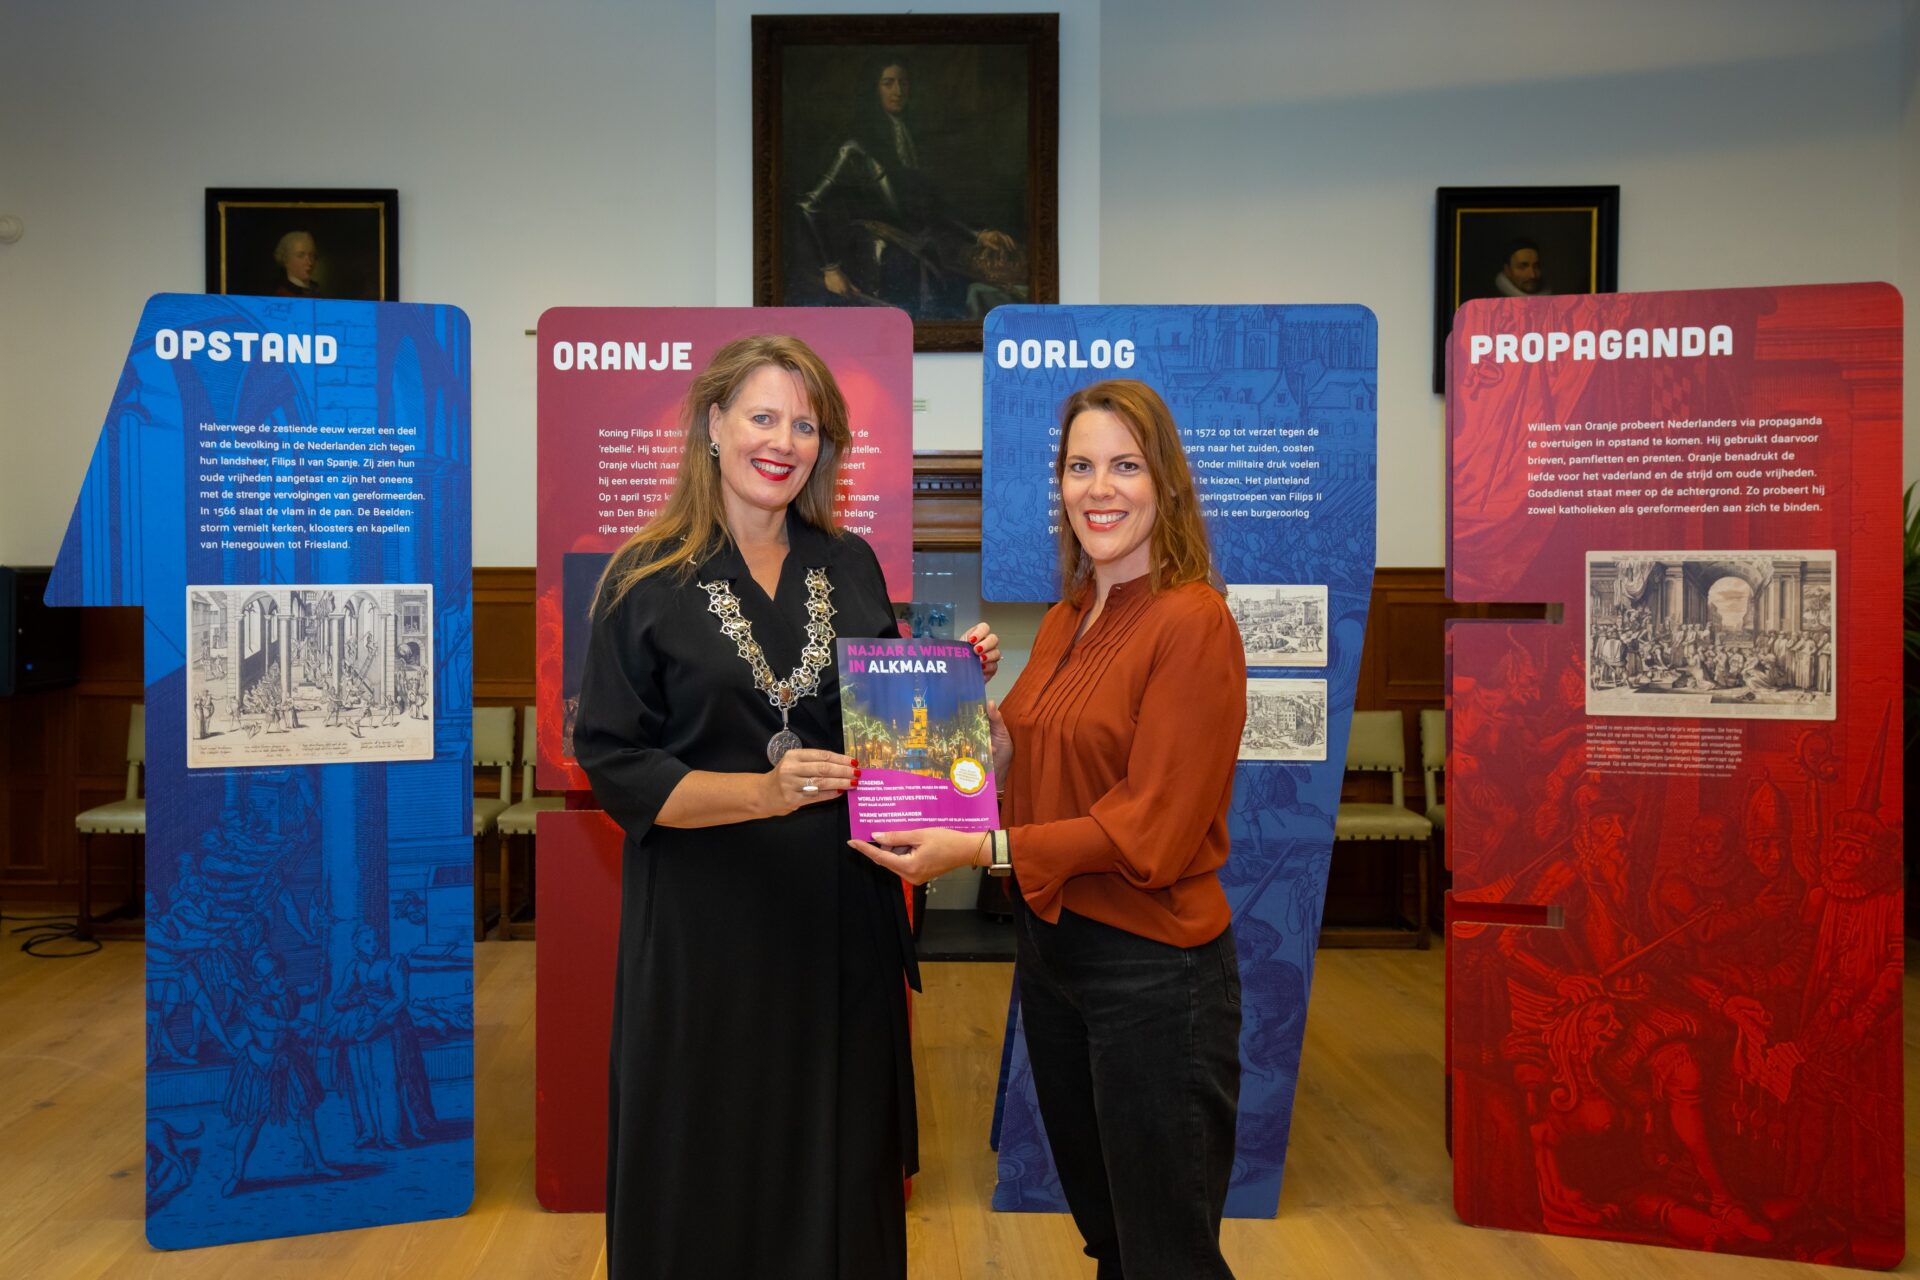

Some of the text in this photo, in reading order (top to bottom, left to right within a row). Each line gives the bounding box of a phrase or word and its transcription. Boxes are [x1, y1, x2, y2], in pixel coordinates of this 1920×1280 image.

[155, 329, 337, 365] OPSTAND
[1471, 324, 1733, 365] PROPAGANDA
[553, 341, 692, 371] ORANJE
[998, 339, 1135, 369] OORLOG
[200, 422, 256, 434] Halverwege
[273, 424, 318, 433] zestiende
[347, 426, 375, 434] verzet
[378, 427, 395, 435] een
[397, 426, 416, 436] deel
[1528, 422, 1562, 432] Willem
[1585, 421, 1618, 432] Oranje
[1621, 420, 1664, 432] probeert
[1667, 418, 1737, 429] Nederlanders
[1740, 418, 1756, 427] via
[1759, 416, 1823, 428] propaganda
[599, 429, 629, 439] Koning
[631, 429, 654, 439] Filips
[656, 429, 661, 437] II
[1195, 428, 1305, 438] 1572 op tot verzet tegen
[234, 440, 279, 451] bevolking
[307, 441, 366, 451] Nederlanden
[369, 442, 387, 451] zich
[389, 443, 415, 453] tegen
[1540, 433, 1819, 450] overtuigen opstand komen. Hij gebruikt daarvoor
[638, 445, 650, 455] Hij
[1231, 444, 1245, 452] het
[1248, 444, 1280, 453] zuiden,
[1283, 444, 1314, 452] oosten
[200, 456, 415, 469] hun landsheer, Filips II van Spanje. Zij zien hun
[1528, 451, 1778, 466] brieven, pamfletten prenten. Oranje benadrukt
[599, 461, 628, 471] Oranje
[630, 461, 657, 469] vlucht
[1198, 460, 1320, 469] Onder militaire druk voelen
[200, 473, 225, 482] oude
[228, 473, 273, 484] vrijheden
[275, 475, 324, 485] aangetast
[342, 475, 358, 485] zijn
[361, 475, 376, 484] het
[1528, 472, 1555, 482] liefde
[1583, 472, 1599, 481] het
[1602, 470, 1652, 480] vaderland
[1686, 469, 1713, 481] strijd
[1716, 471, 1733, 479] om
[1736, 469, 1762, 478] oude
[1765, 468, 1817, 480] vrijheden.
[599, 476, 609, 487] hij
[1211, 476, 1310, 486] kiezen. Het platteland
[200, 490, 425, 502] met strenge vervolgingen van gereformeerden.
[1528, 484, 1825, 498] Godsdienst staat meer op achtergrond. Zo probeert hij
[599, 493, 611, 503] Op
[621, 493, 639, 503] april
[642, 494, 662, 503] 1572
[848, 493, 880, 502] inname
[1289, 492, 1313, 502] Filips
[1316, 492, 1322, 501] II
[200, 507, 414, 518] In 1566 slaat vlam pan. De Beelden-
[617, 509, 635, 517] Den
[844, 509, 877, 519] belang-
[1221, 508, 1229, 517] is
[1251, 508, 1310, 519] burgeroorlog
[1528, 505, 1556, 515] zowel
[1559, 505, 1616, 514] katholieken
[1619, 504, 1634, 514] als
[1637, 503, 1719, 515] gereformeerden
[1745, 503, 1767, 512] zich
[1783, 502, 1823, 512] binden.
[200, 524, 410, 534] storm vernielt kerken, kloosters kapellen
[599, 524, 618, 535] rijke
[221, 540, 285, 551] Henegouwen
[288, 541, 301, 549] tot
[305, 540, 350, 549] Friesland.
[847, 644, 971, 658] NAJAAR & WINTER
[848, 658, 948, 674] IN ALKMAAR
